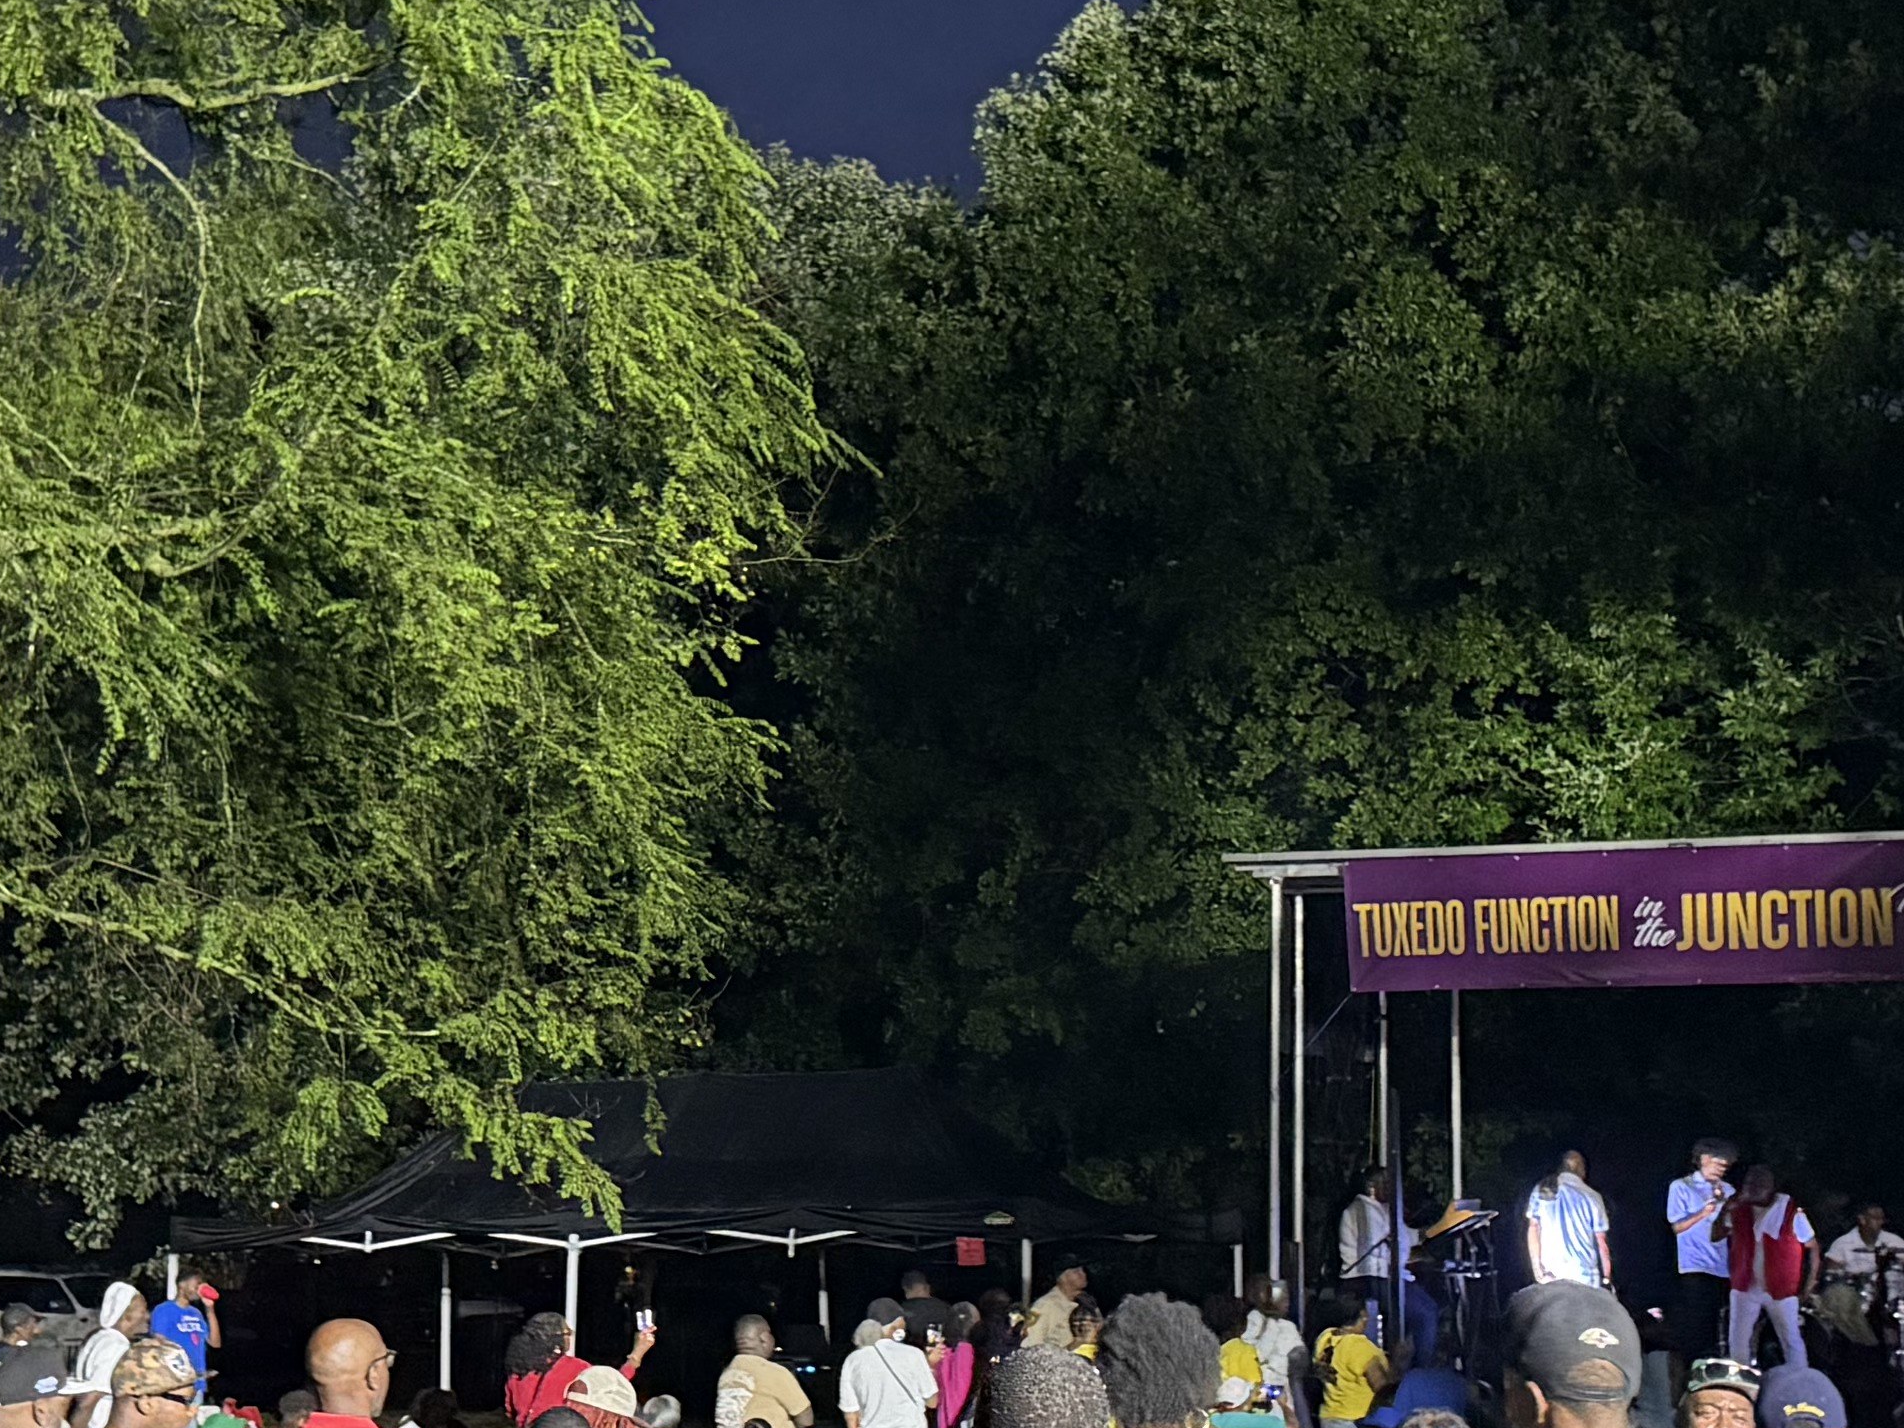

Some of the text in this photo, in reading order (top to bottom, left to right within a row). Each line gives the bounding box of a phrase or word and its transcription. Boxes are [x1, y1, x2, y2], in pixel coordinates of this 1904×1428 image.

[1352, 888, 1894, 958] TUXEDO FUNCTION in the JUNCTION
